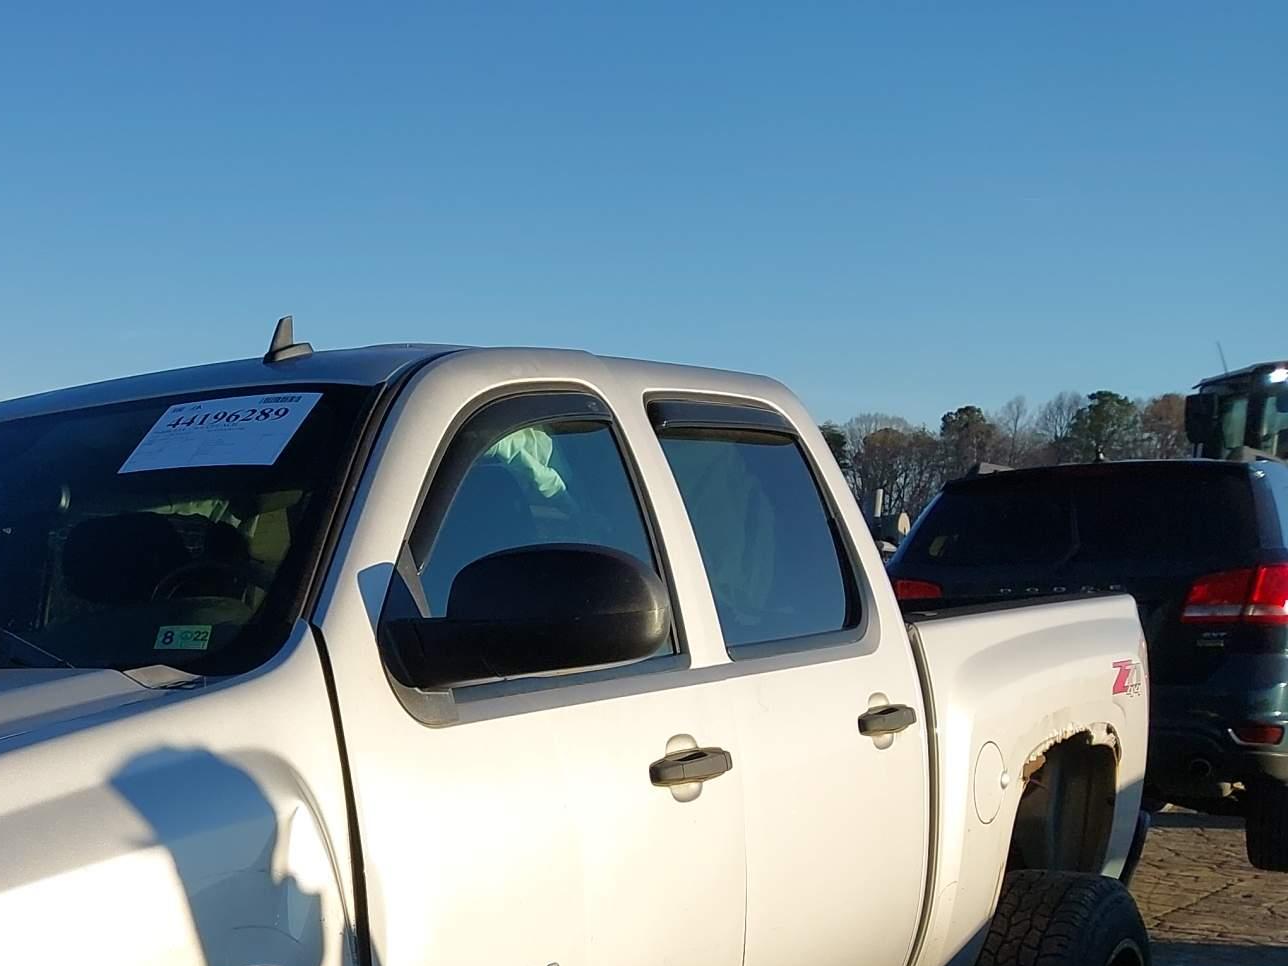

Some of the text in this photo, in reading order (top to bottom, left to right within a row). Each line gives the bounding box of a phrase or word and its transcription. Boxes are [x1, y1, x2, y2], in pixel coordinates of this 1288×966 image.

[167, 407, 289, 428] 44196289
[162, 630, 209, 645] 8 22
